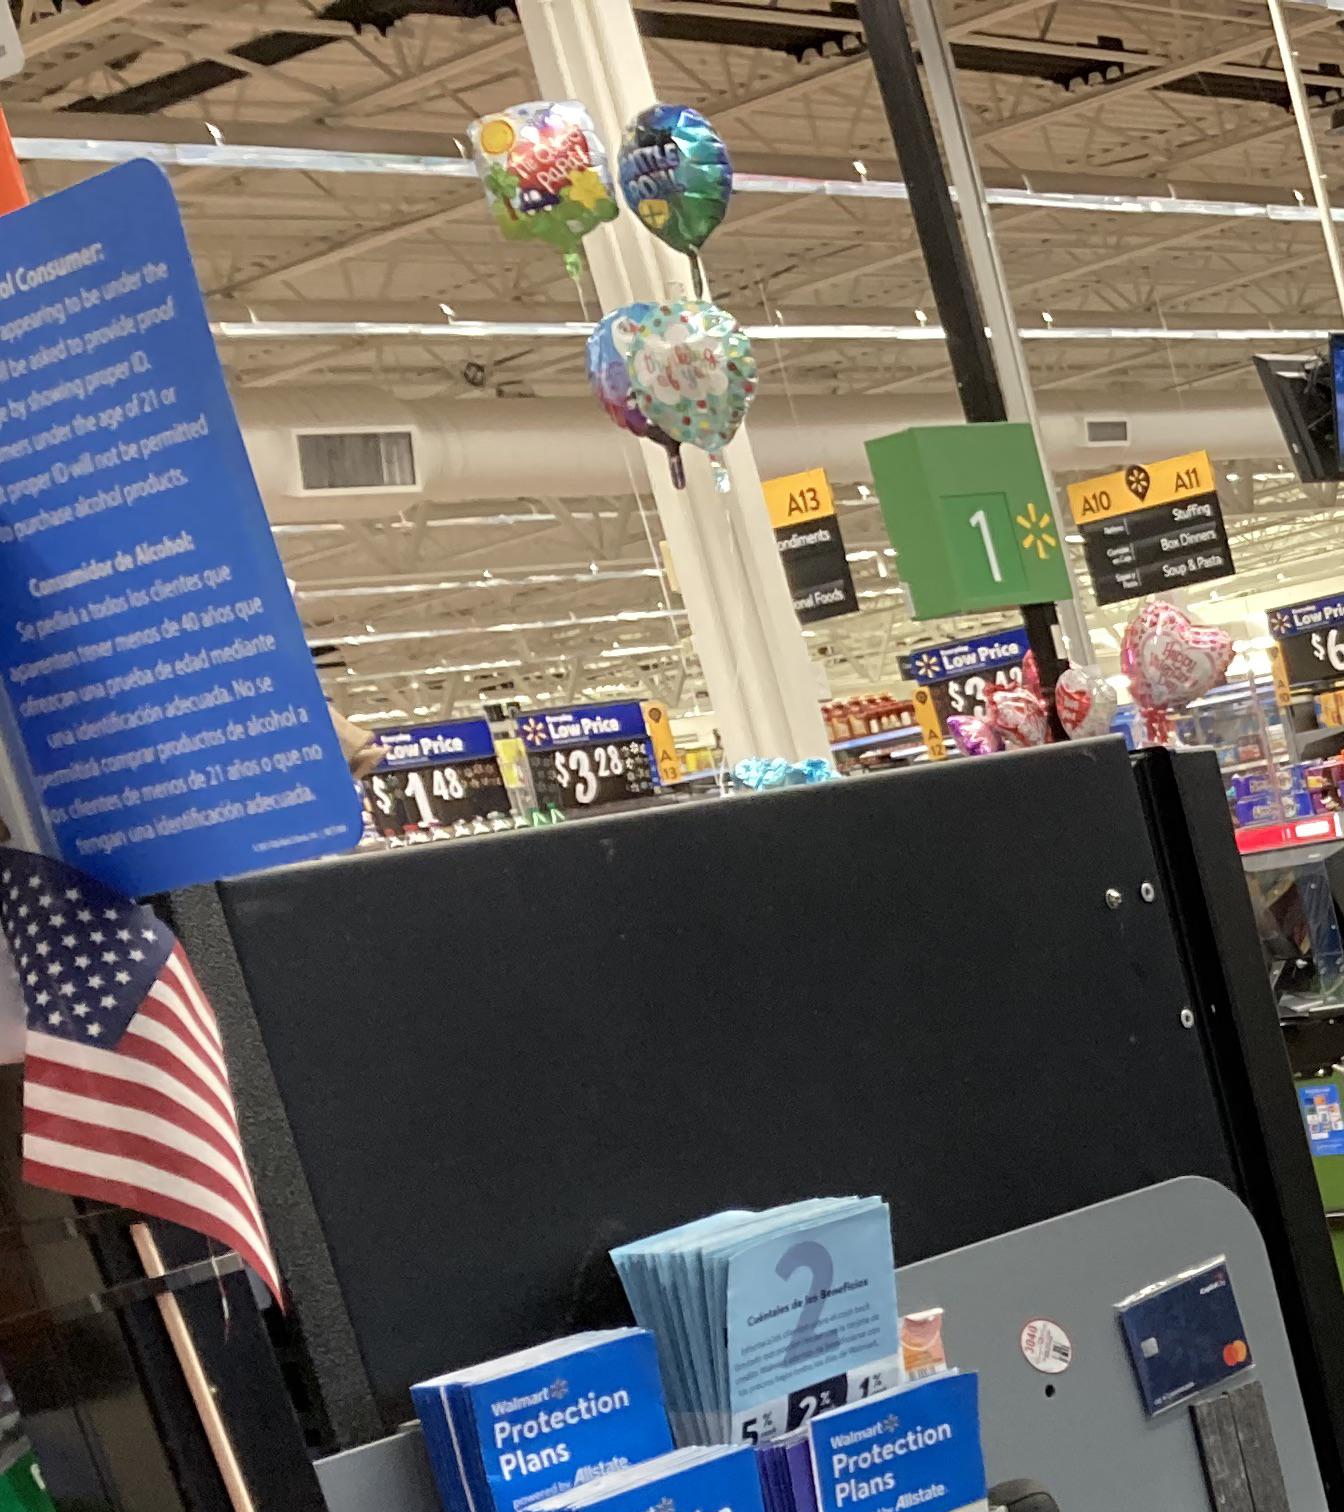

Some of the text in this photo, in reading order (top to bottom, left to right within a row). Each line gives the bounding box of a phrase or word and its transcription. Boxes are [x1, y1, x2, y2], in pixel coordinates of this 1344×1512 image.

[788, 487, 820, 517] A13
[1080, 467, 1200, 516] A10 A11
[1172, 503, 1212, 521] Stuffing
[968, 508, 1003, 583] 1
[1160, 529, 1217, 551] Box Dinners
[1162, 563, 1187, 578] Soup
[1197, 554, 1223, 569] Pasta
[814, 588, 845, 607] Foods
[1293, 608, 1324, 629] Low
[940, 642, 1020, 671] Low Price
[548, 715, 620, 741] Low Price
[385, 734, 464, 761] Low Price
[820, 1279, 868, 1300] Beneficios
[775, 1241, 833, 1368] 2
[490, 1387, 550, 1417] Walmart
[493, 1389, 630, 1449] Protection
[830, 1421, 883, 1449] Walmart
[498, 1443, 571, 1481] Plans
[832, 1423, 952, 1478] Protection
[835, 1472, 896, 1507] Plans
